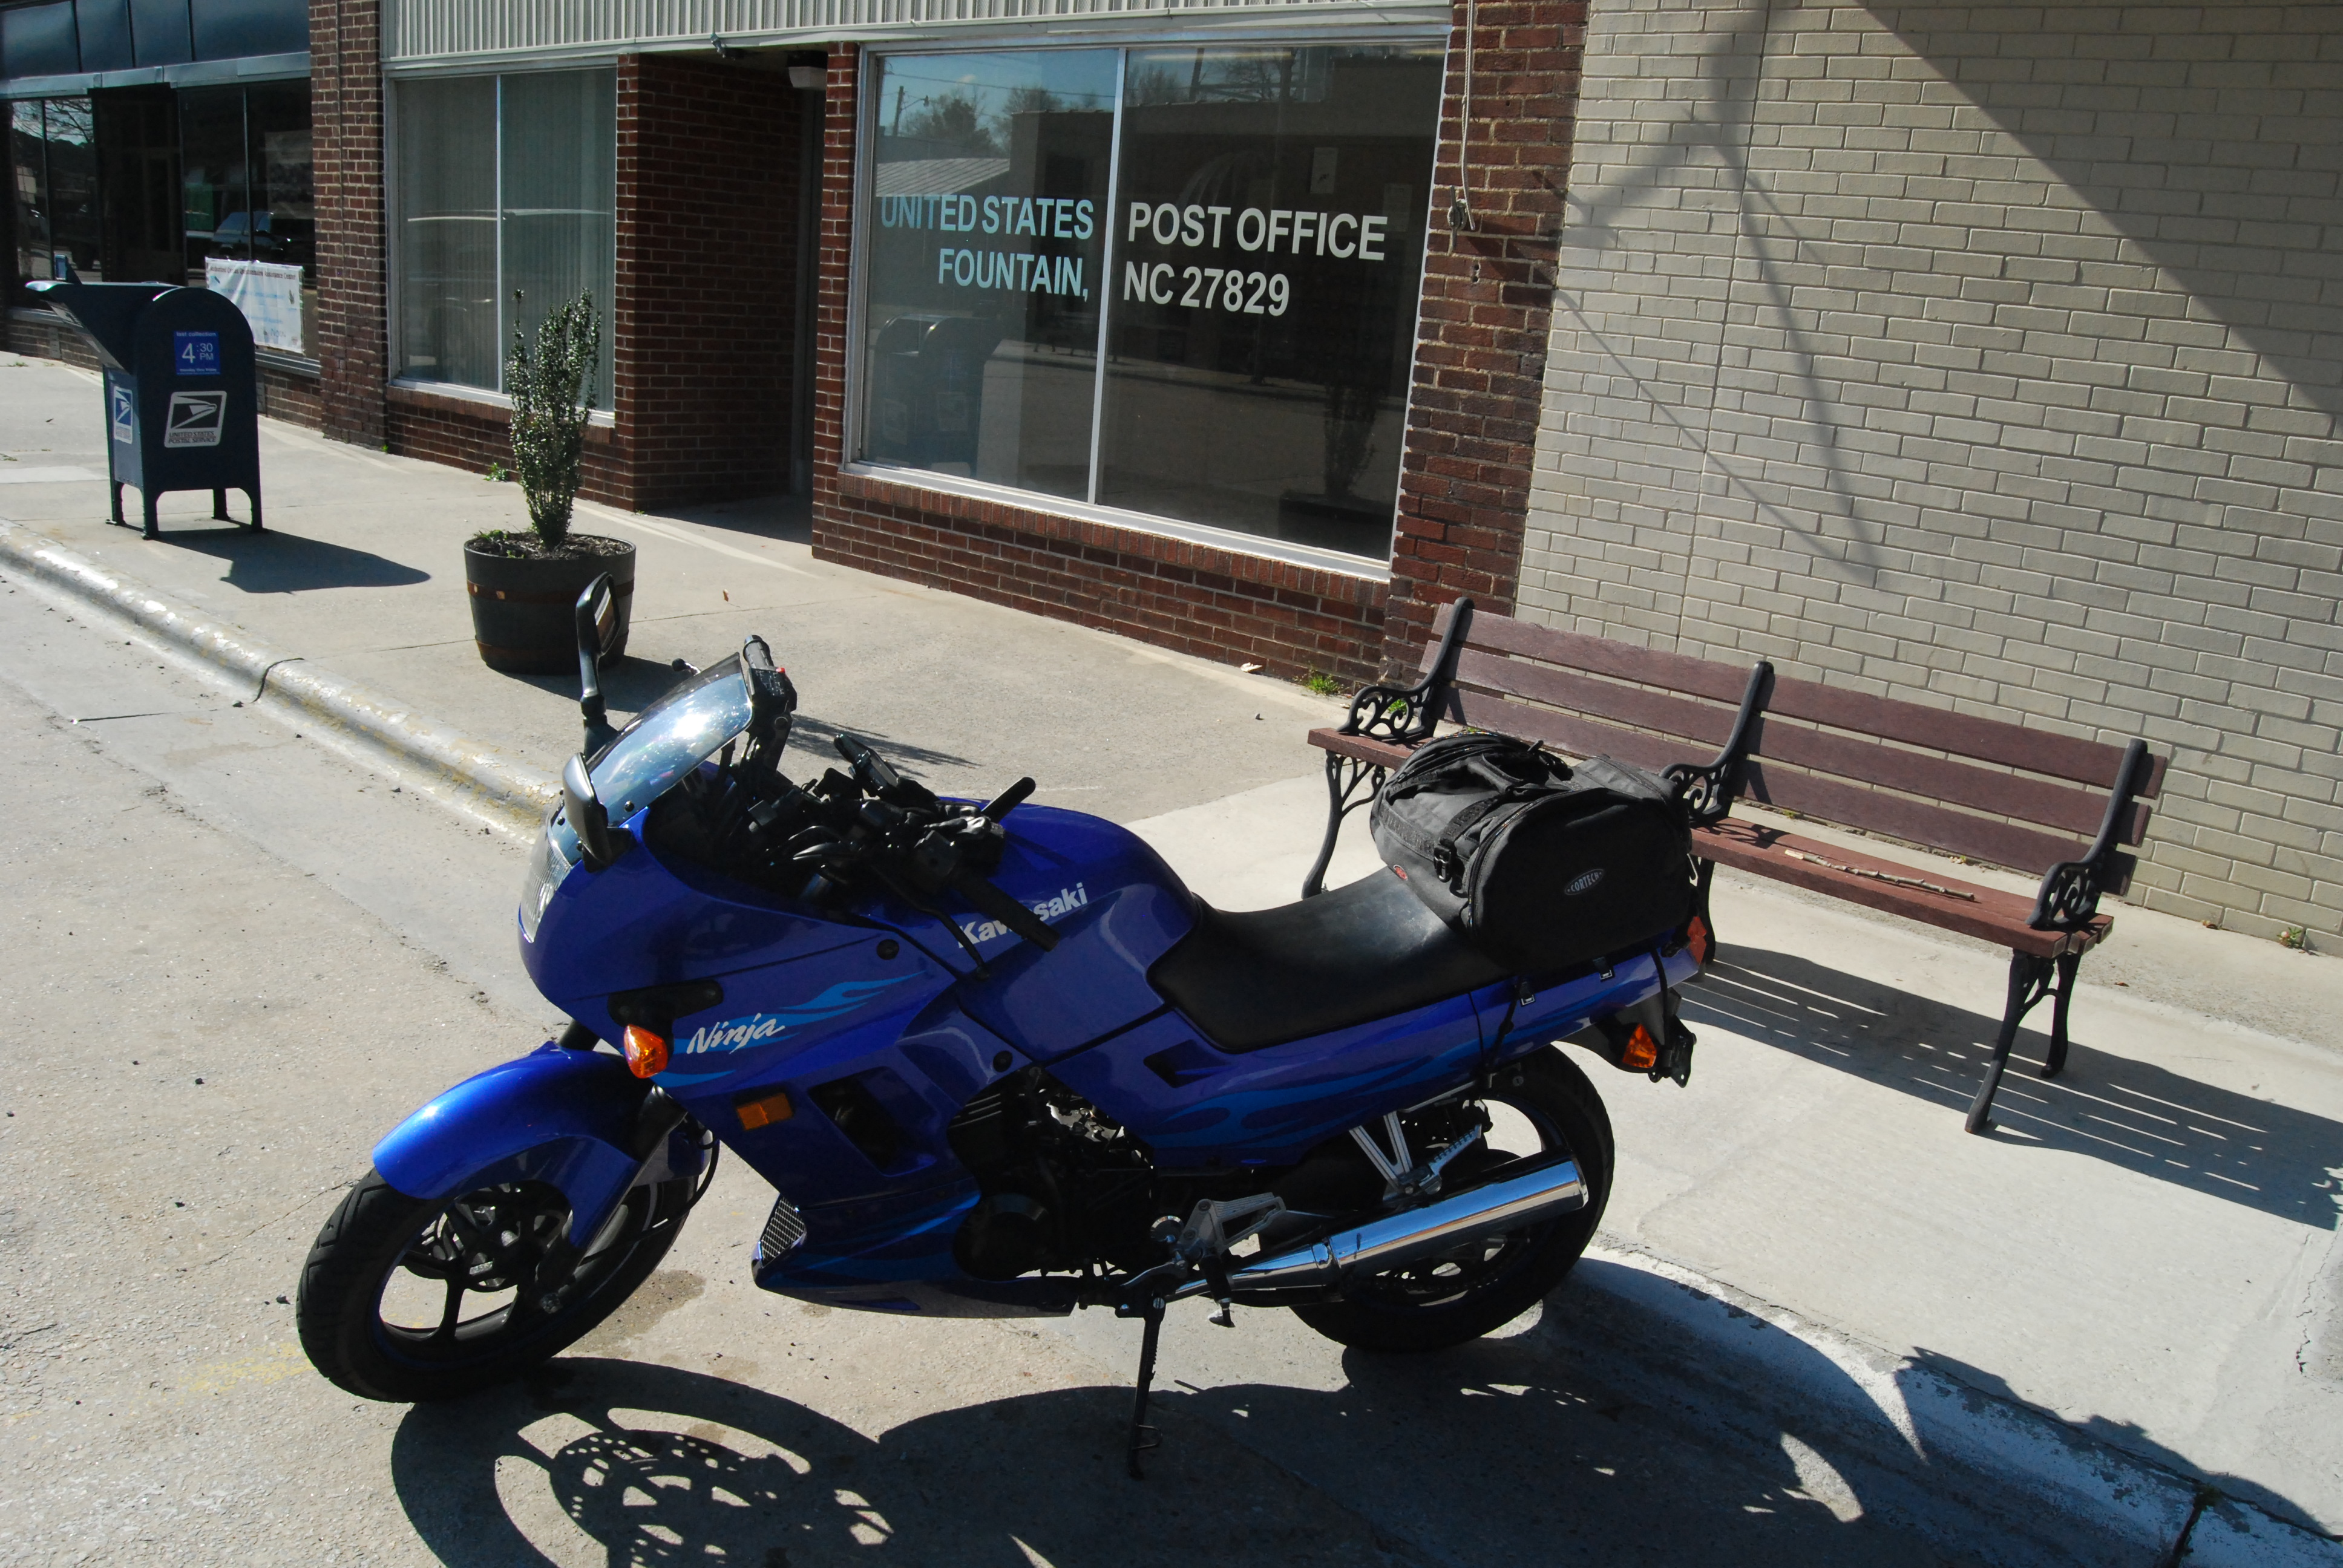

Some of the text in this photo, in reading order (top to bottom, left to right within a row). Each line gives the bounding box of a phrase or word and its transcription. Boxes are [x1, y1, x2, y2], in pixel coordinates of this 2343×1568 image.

[881, 194, 1388, 261] UNITED STATES POST OFFICE
[939, 248, 1289, 316] FOUNTAIN, NC 27829
[958, 882, 1088, 949] Kasaki
[1570, 872, 1599, 892] CORTECH
[686, 1013, 785, 1054] Ninja
